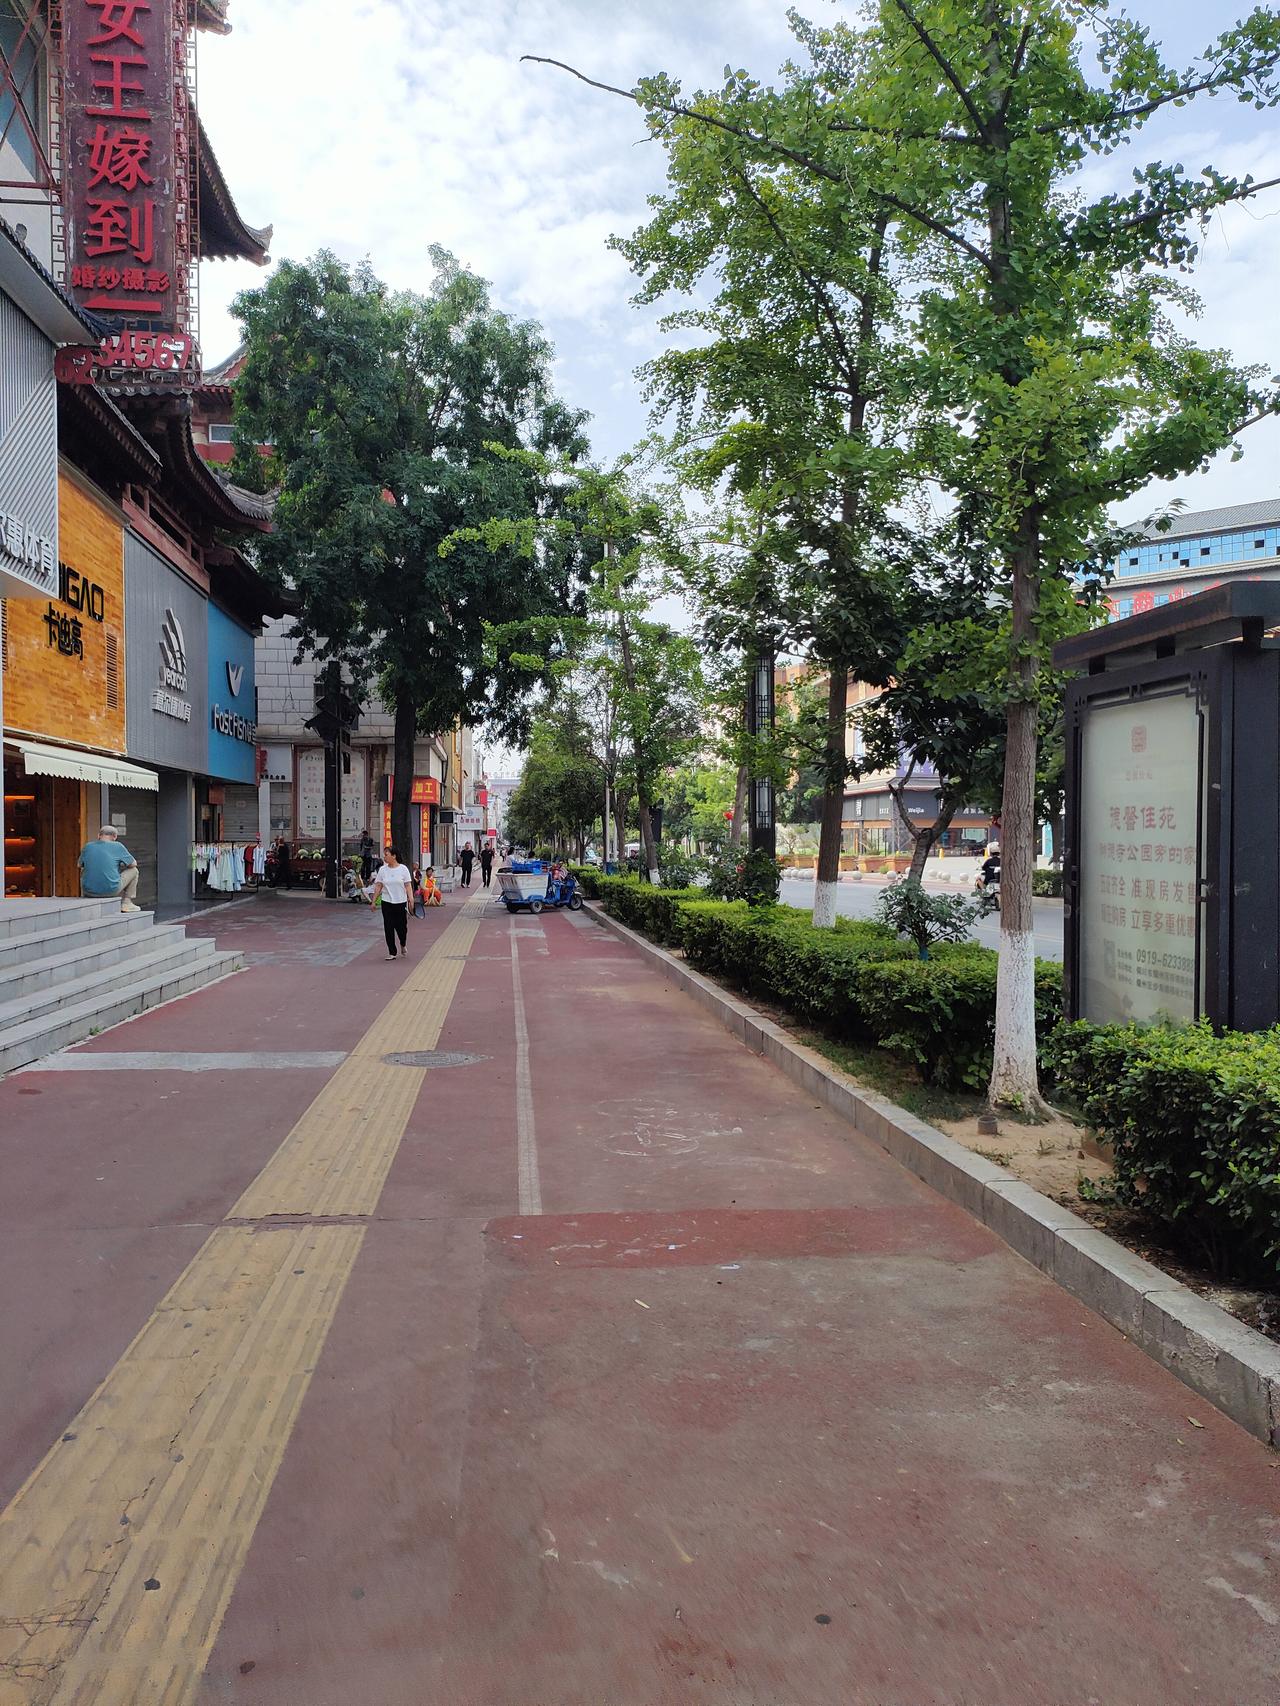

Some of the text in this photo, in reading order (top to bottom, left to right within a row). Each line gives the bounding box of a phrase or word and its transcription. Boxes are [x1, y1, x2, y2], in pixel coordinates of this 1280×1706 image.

[85, 0, 155, 264] 女王嫁到
[72, 265, 171, 294] 婚纱摄影
[43, 601, 84, 662] 卡迪高
